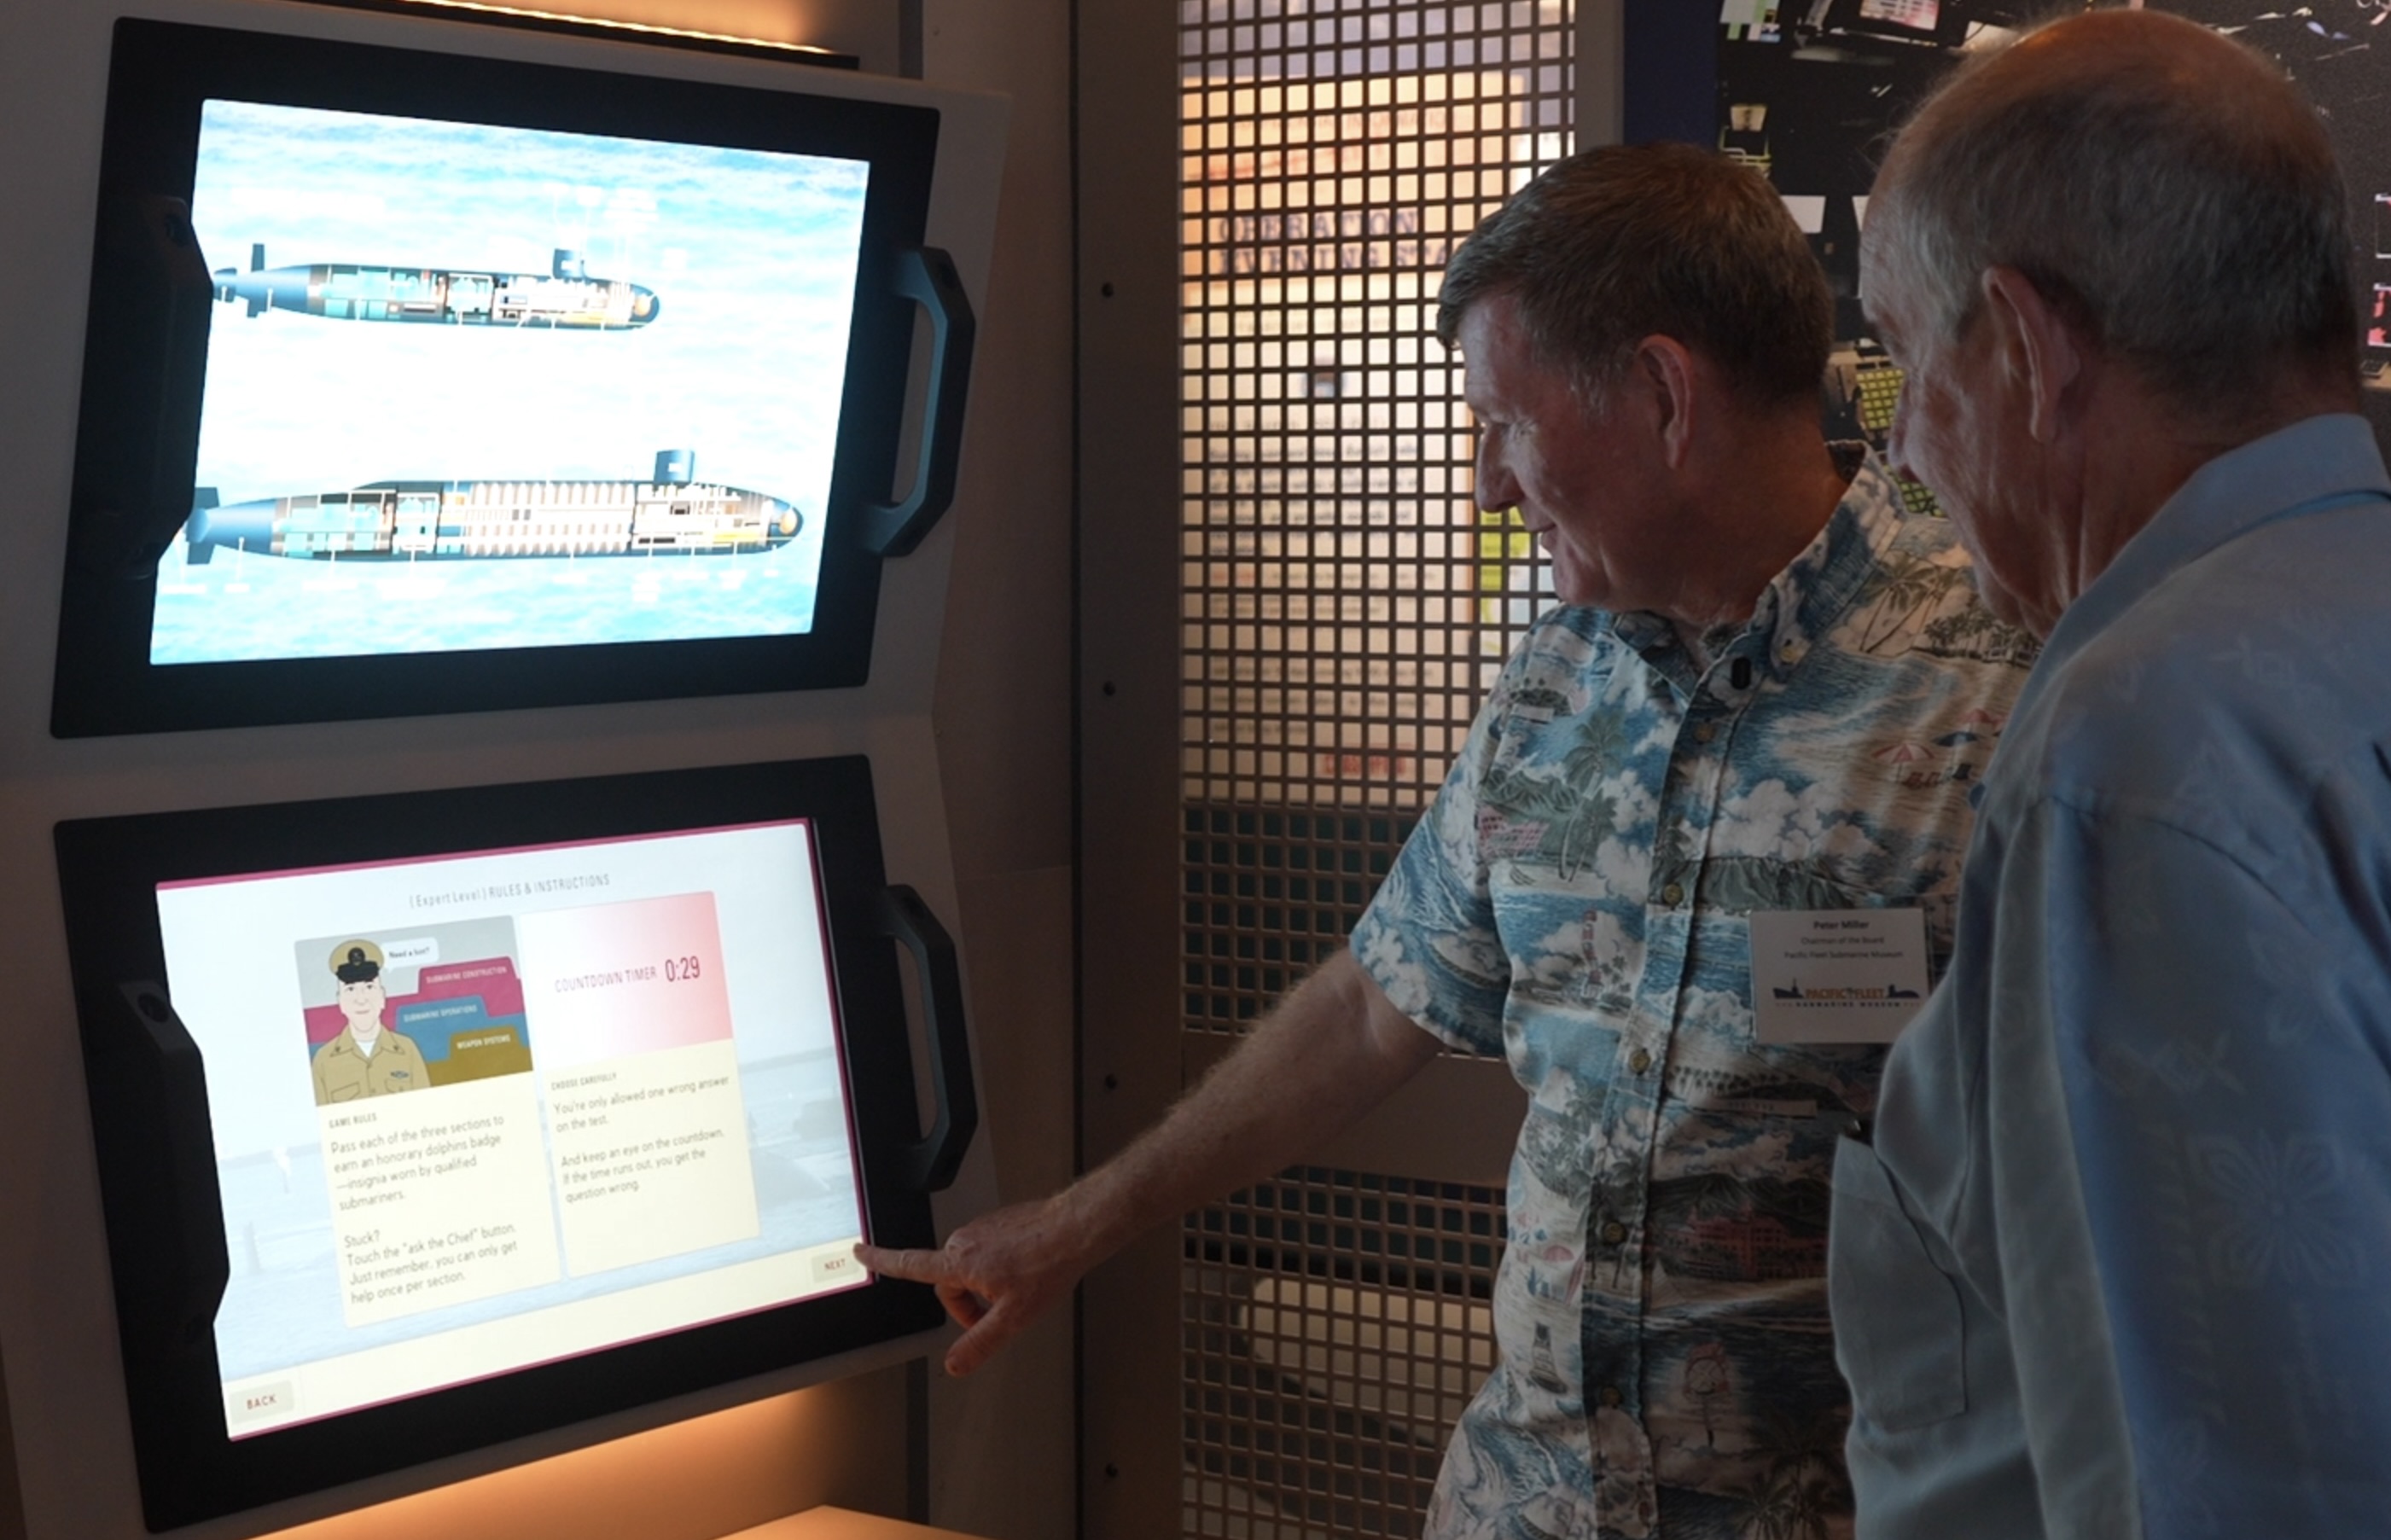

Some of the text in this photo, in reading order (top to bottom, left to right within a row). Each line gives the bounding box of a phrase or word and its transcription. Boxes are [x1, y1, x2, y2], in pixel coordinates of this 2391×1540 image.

[1219, 207, 1418, 242] OPERATON
[488, 882, 522, 898] RULES
[524, 881, 532, 894] &
[533, 873, 610, 893] INSTRUCTIONS
[1813, 921, 1870, 930] Peter Miller
[426, 966, 508, 984] SUBMARINE CONSTRUCTION
[555, 956, 701, 993] COUNTDOWN TIMER 0:29
[1806, 988, 1884, 999] PACIFIC FLEET
[404, 1004, 478, 1023] SUBMARINE OPERATIONS
[457, 1034, 511, 1049] WEAPON SYSTEMS
[550, 1072, 617, 1091] CHOOSE CAREFULLY
[553, 1075, 730, 1115] You're only allowed one wrong answer
[329, 1113, 377, 1129] GAME RULES
[556, 1114, 609, 1134] on the test.
[331, 1115, 504, 1154] Pass each of the three sections to
[334, 1132, 502, 1173] earn an honorary dolphins badge
[561, 1154, 581, 1168] And
[583, 1150, 607, 1165] keep
[609, 1148, 620, 1159] an
[623, 1144, 640, 1157] eye
[642, 1141, 654, 1152] on
[655, 1137, 671, 1149] the
[390, 1168, 416, 1182] worn
[419, 1165, 431, 1178] by
[434, 1154, 477, 1175] qualified
[572, 1171, 587, 1183] the
[590, 1167, 610, 1180] time
[613, 1164, 634, 1176] runs
[655, 1156, 672, 1170] you
[674, 1152, 689, 1165] get
[691, 1148, 706, 1159] the
[565, 1186, 607, 1205] question
[344, 1229, 381, 1249] Stuck?
[347, 1249, 381, 1266] Touch
[383, 1246, 400, 1259] the
[428, 1238, 445, 1250] the
[350, 1271, 373, 1286] Just
[436, 1254, 455, 1270] you
[457, 1248, 475, 1263] can
[478, 1243, 498, 1260] only
[501, 1240, 518, 1256] get
[824, 1258, 845, 1270] NEXT
[350, 1270, 466, 1305] help once per section.
[247, 1394, 276, 1409] BACK
